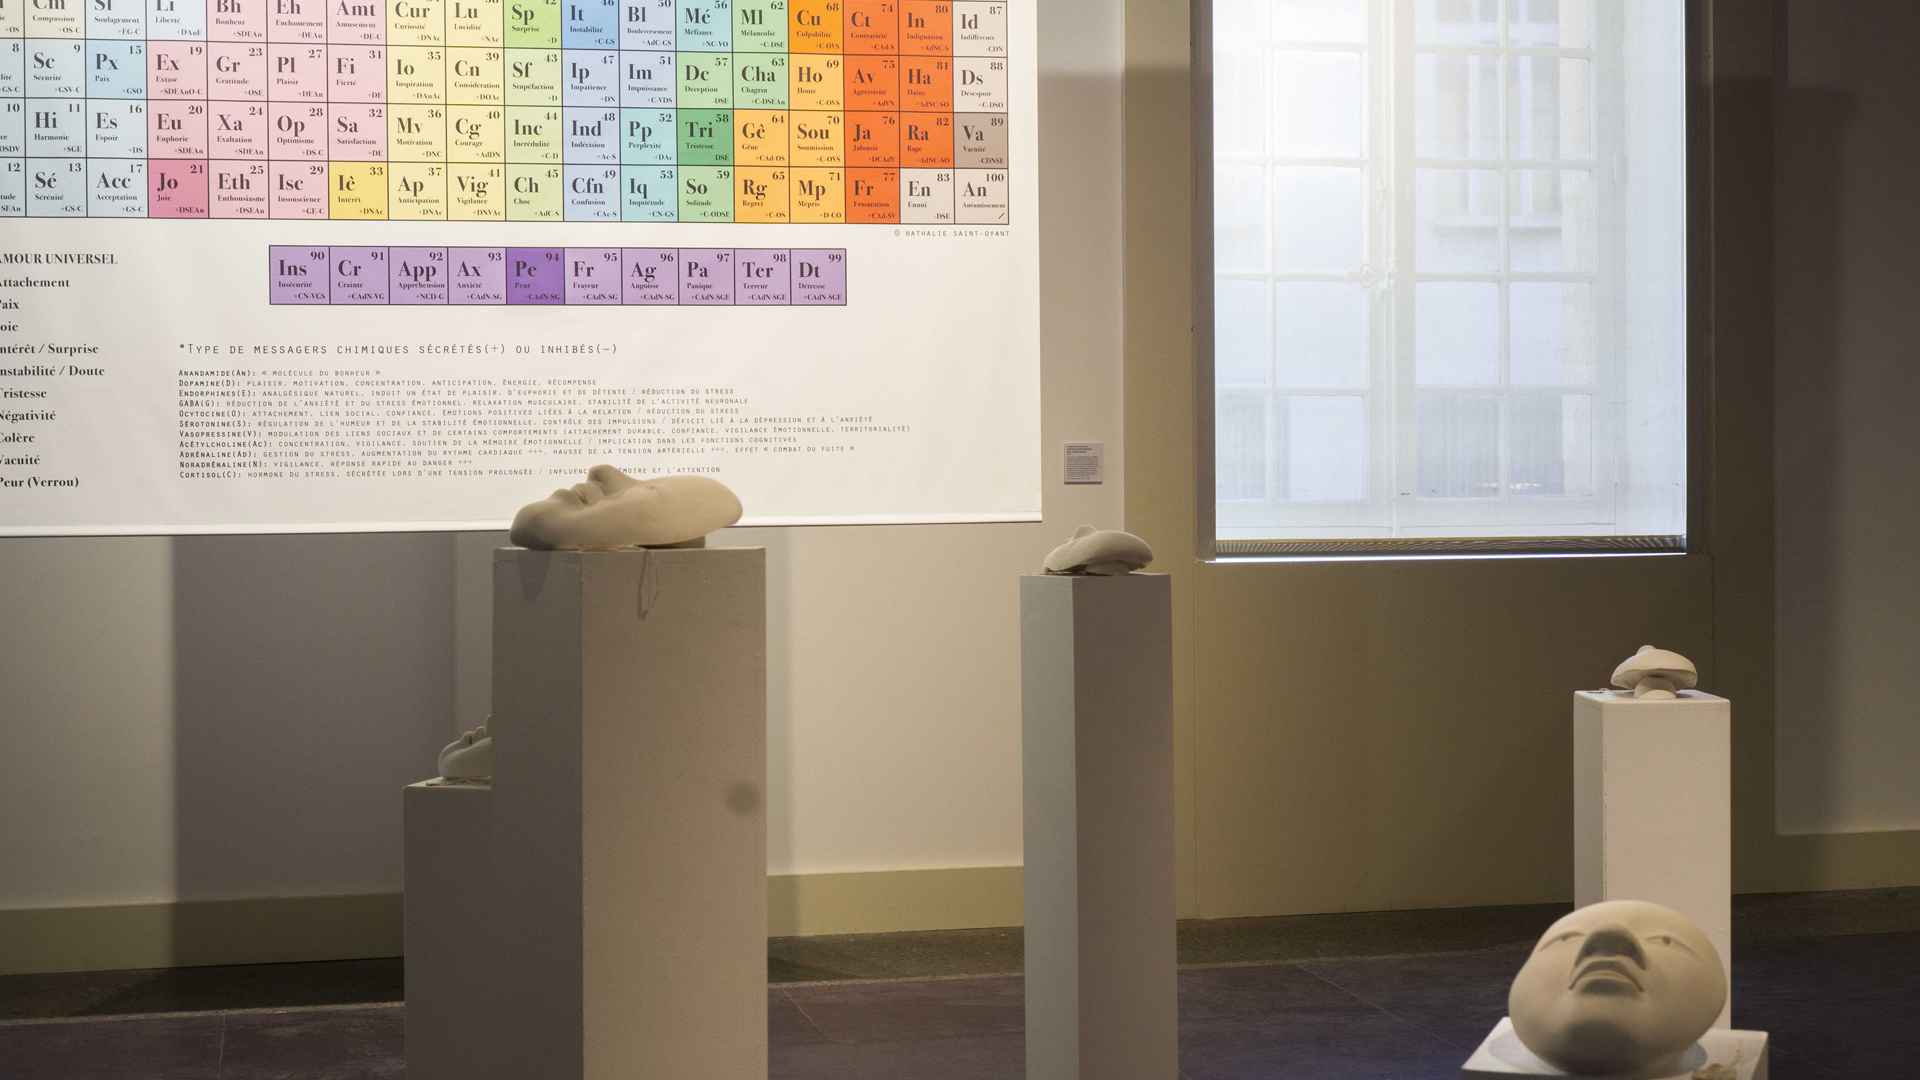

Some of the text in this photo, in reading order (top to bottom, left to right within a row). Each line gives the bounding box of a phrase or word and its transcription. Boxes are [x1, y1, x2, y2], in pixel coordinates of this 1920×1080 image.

[32, 15, 75, 23] Compassion
[512, 4, 534, 25] Sp
[571, 5, 584, 21] It
[628, 6, 646, 22] Bl
[741, 9, 763, 25] Ml
[797, 10, 821, 26] Cu
[851, 12, 870, 27] Ct
[908, 12, 924, 28] In
[961, 14, 978, 29] Id
[130, 45, 142, 54] 15
[96, 53, 118, 70] Px
[157, 54, 180, 71] Ex
[216, 56, 240, 72] Gr
[278, 57, 295, 73] Pl
[337, 58, 354, 74] Fi
[397, 59, 414, 75] Io
[771, 58, 785, 66] 63
[571, 62, 590, 84] Ip
[629, 63, 652, 80] Im
[798, 67, 823, 83] Ho
[908, 69, 931, 85] Ha
[962, 70, 983, 85] Ds
[396, 80, 433, 88] Inspiration
[188, 105, 203, 114] 20
[369, 108, 382, 118] 32
[35, 112, 57, 128] Hi
[96, 112, 118, 129] Es
[157, 113, 182, 130] Eu
[218, 114, 243, 131] Xa
[277, 115, 305, 137] Op
[337, 116, 358, 133] Sa
[397, 117, 423, 133] Mv
[95, 134, 118, 143] Espoir
[797, 124, 829, 140] Sou
[853, 124, 871, 142] Ja
[963, 125, 984, 141] Va
[157, 172, 178, 192] Jo
[218, 173, 250, 190] Eth
[514, 177, 539, 193] Ch
[937, 173, 950, 182] 83
[398, 176, 424, 197] Ap
[457, 176, 489, 198] Vig
[686, 178, 708, 194] So
[799, 180, 826, 201] Mp
[909, 181, 931, 197] En
[963, 182, 987, 197] An
[45, 253, 118, 264] UNIVERSEL
[773, 254, 787, 262] 98
[279, 259, 307, 276] Ins
[338, 260, 361, 276] Cr
[687, 262, 708, 278] Pa
[799, 262, 821, 278] Dt
[687, 282, 713, 291] Panique
[0, 298, 20, 310] aix
[48, 343, 99, 357] Surprise
[229, 345, 244, 354] DE
[254, 345, 327, 354] MESSAGERS
[336, 345, 409, 354] CHIMIQUES
[515, 345, 530, 354] OU
[69, 365, 105, 376] Doute
[27, 476, 79, 489] (Verrou)
